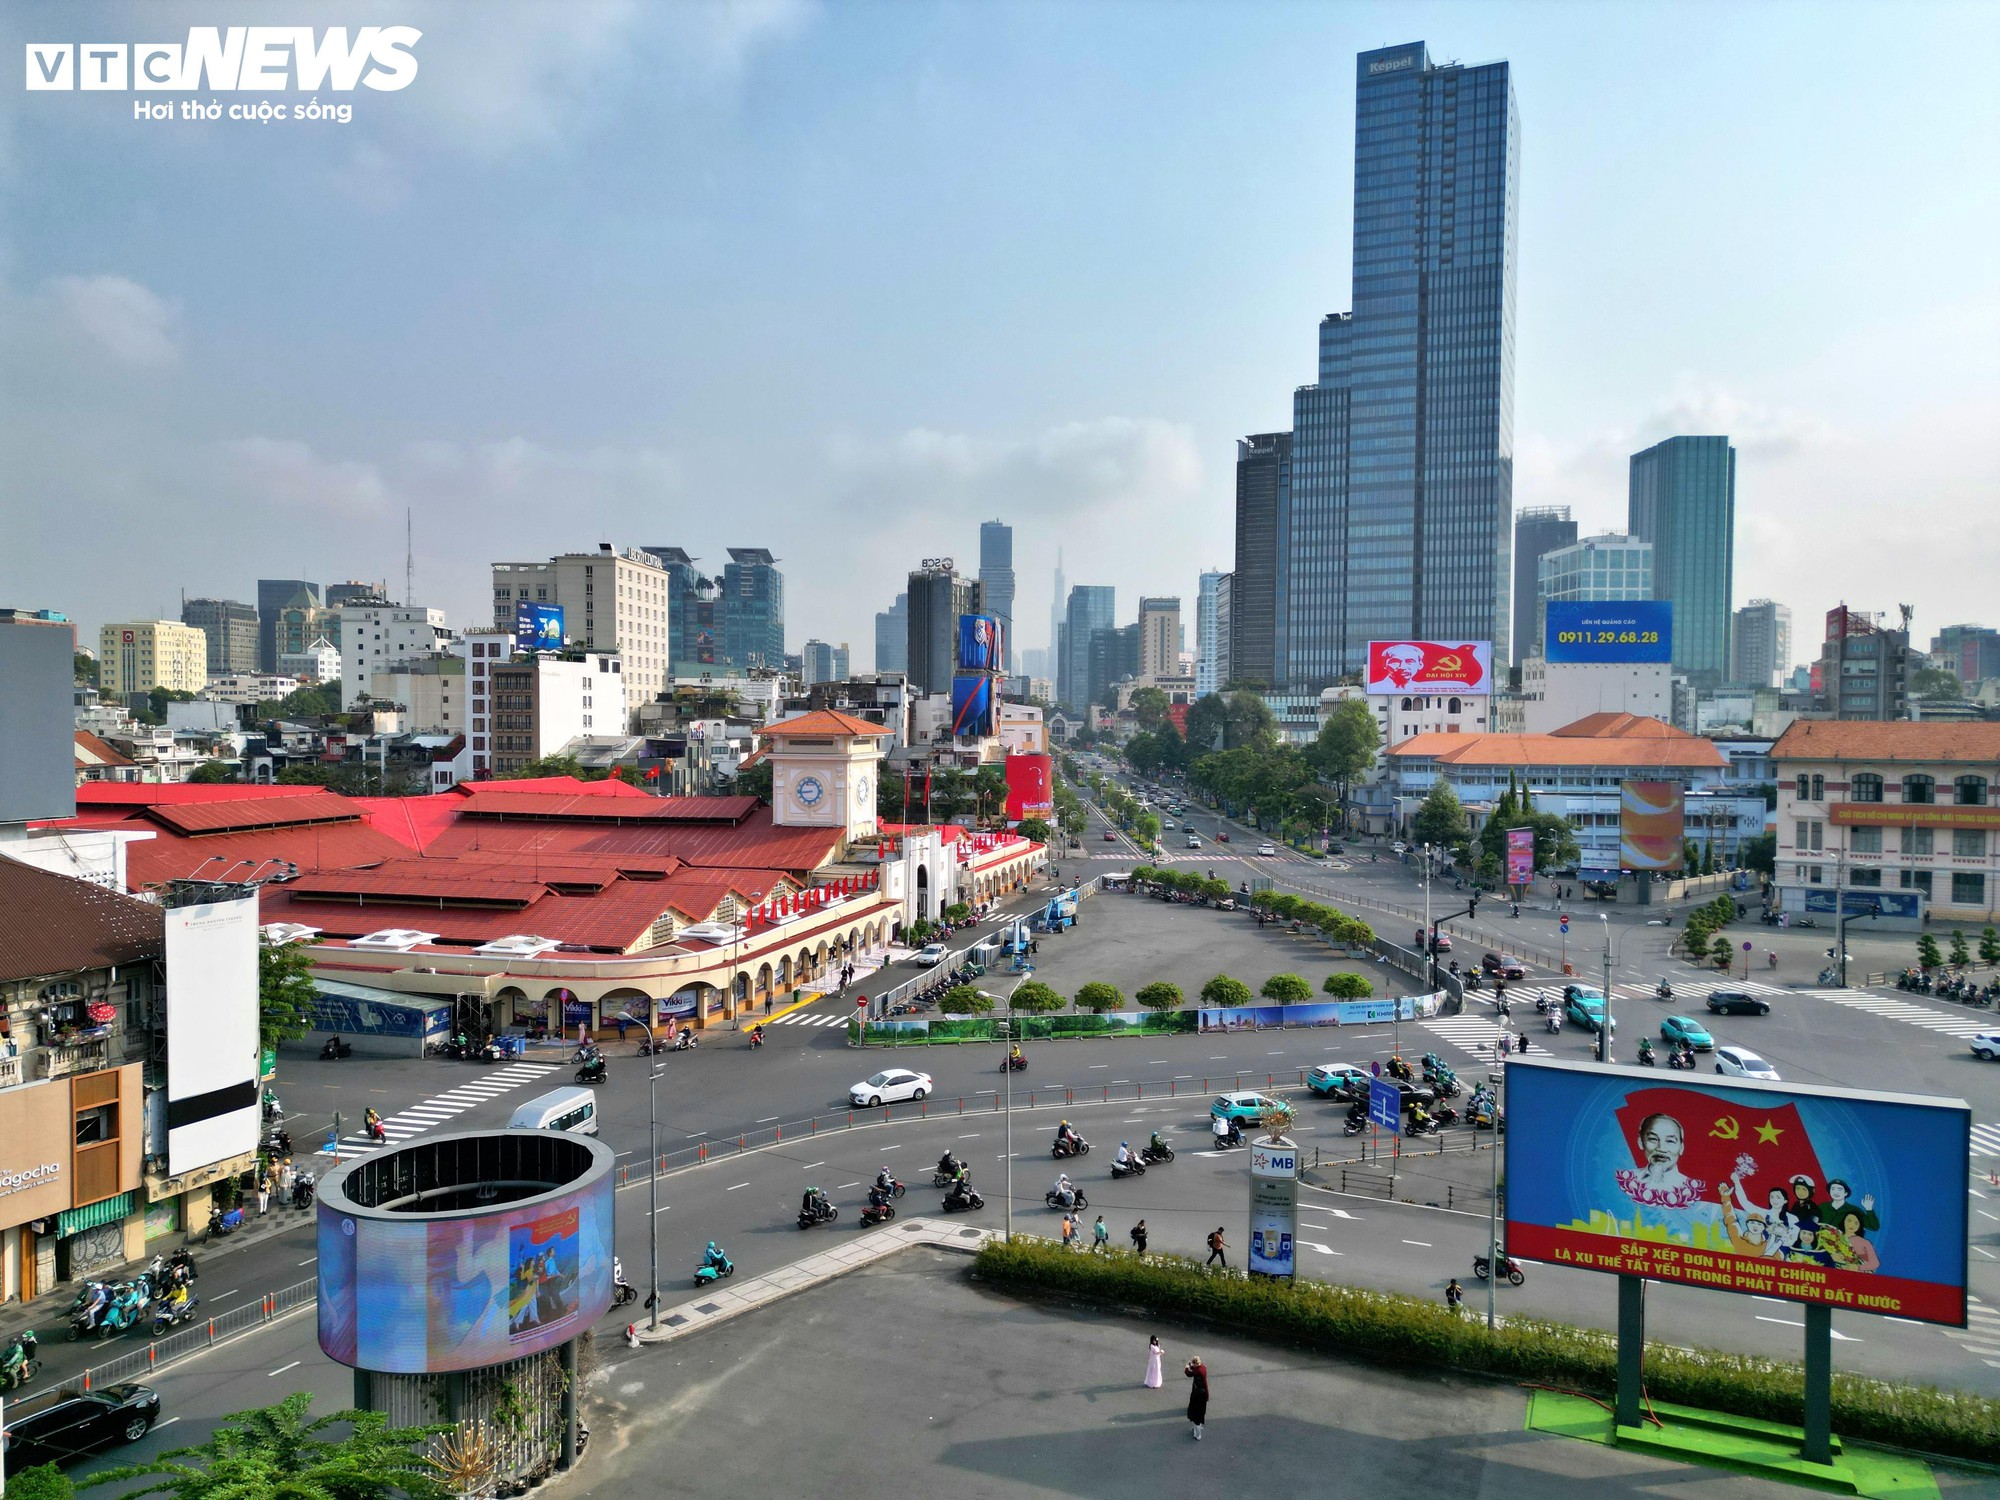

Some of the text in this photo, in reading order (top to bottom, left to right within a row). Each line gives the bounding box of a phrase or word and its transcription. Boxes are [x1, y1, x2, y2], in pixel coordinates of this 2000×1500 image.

[1370, 57, 1412, 73] Keppel
[1558, 631, 1659, 643] 0911.29.68.28
[662, 997, 683, 1007] Vikki
[1271, 1157, 1294, 1169] MB
[0, 1162, 60, 1187] agocha
[1652, 1247, 1679, 1262] XẾP
[1684, 1253, 1713, 1267] ĐƠN
[1718, 1259, 1731, 1272] VỊ
[1736, 1260, 1776, 1276] HÀNH
[1780, 1267, 1826, 1284] CHÍNH
[1555, 1248, 1901, 1311] LÀ XU THẾ TẤT YẾU TRONG PHÁT TRIỂN ĐẤT NƯỚC
